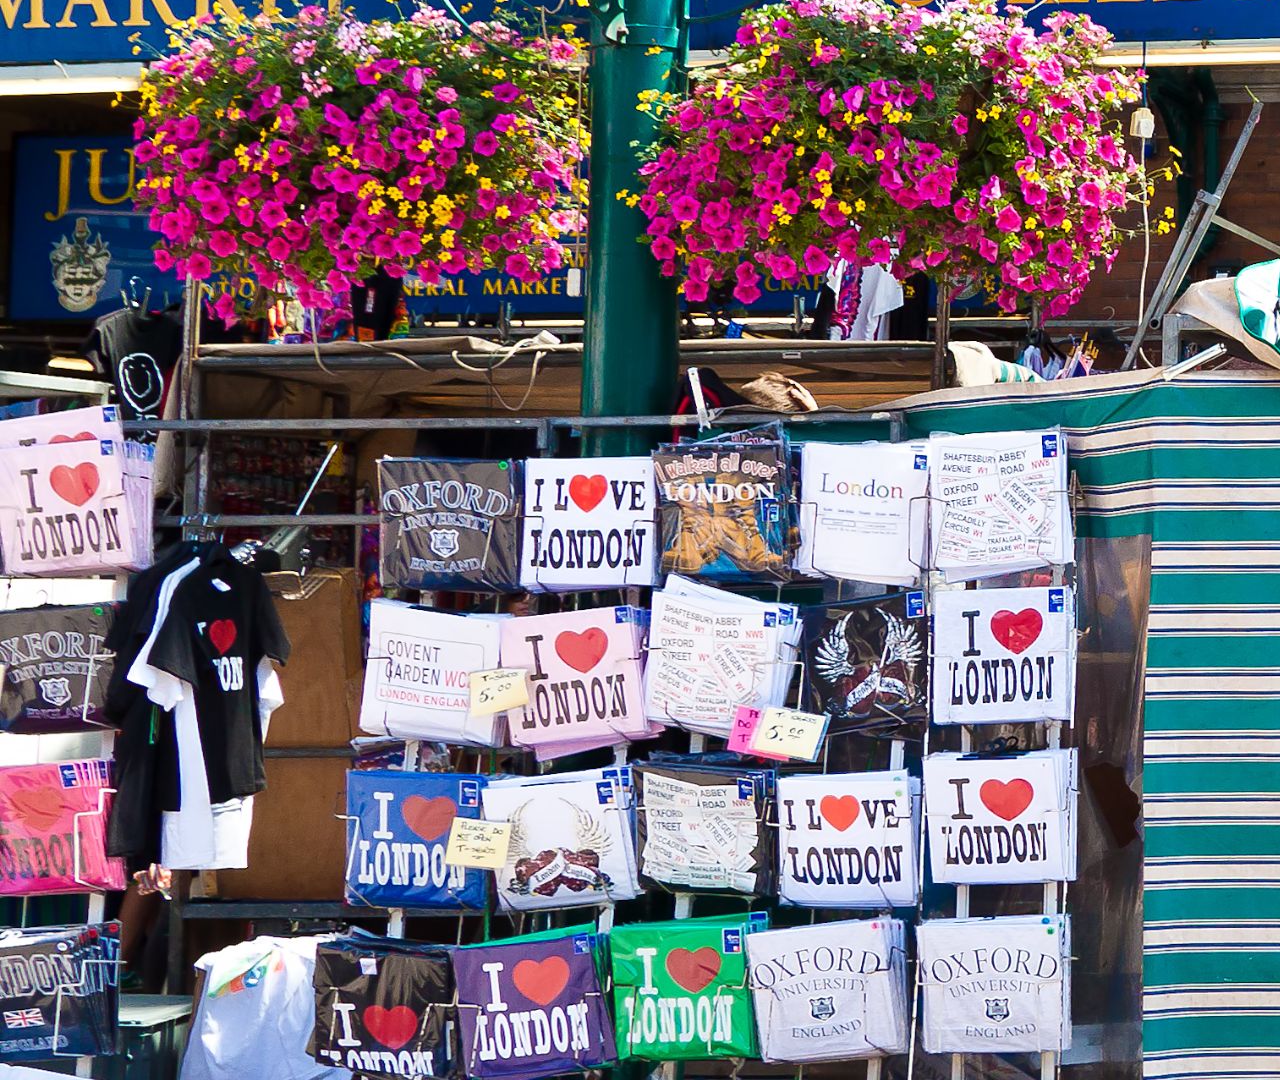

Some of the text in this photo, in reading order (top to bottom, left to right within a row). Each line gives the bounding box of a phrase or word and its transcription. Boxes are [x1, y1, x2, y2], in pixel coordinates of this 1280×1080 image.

[720, 452, 740, 472] all
[741, 459, 780, 481] over
[942, 464, 972, 473] AVENUE
[943, 452, 996, 464] SHAFTESBURY
[998, 450, 1027, 463] ABBEY
[1000, 464, 1025, 476] ROAD
[20, 469, 44, 513] I
[382, 479, 510, 518] OXFORD
[532, 478, 545, 512] I
[663, 482, 779, 504] LONDON
[819, 472, 904, 499] London
[943, 482, 980, 496] OXFORD
[1010, 482, 1036, 507] REGENT
[1002, 491, 1028, 515] STREET
[17, 507, 122, 561] LONDON
[530, 528, 646, 569] LONDON
[409, 557, 482, 573] ENGLAND
[662, 615, 690, 630] AVENUE
[715, 617, 743, 626] ABBEY
[715, 629, 740, 639] ROAD
[962, 609, 981, 657] I
[386, 639, 442, 663] COVENT
[661, 637, 695, 649] OXFORD
[525, 634, 549, 682] I
[444, 670, 470, 689] WC
[949, 655, 1055, 706] LONDON
[379, 687, 470, 709] LONDON ENGLAN
[521, 673, 627, 730] LONDON
[948, 777, 974, 820] I
[372, 791, 394, 840] I
[783, 800, 796, 830] I
[942, 822, 1047, 866] LONDON
[786, 845, 903, 886] LONDON
[635, 947, 659, 997] I
[754, 946, 882, 990] OXFORD
[930, 946, 1059, 985] OXFORD
[482, 961, 508, 1012] I
[772, 978, 870, 1003] UNIVERSITY
[948, 978, 1046, 999] UNIVERSITY
[332, 1002, 361, 1047] I
[478, 1002, 590, 1061] LONDON
[624, 994, 734, 1044] LONDON
[791, 1018, 862, 1040] ENGLAND
[964, 1023, 1036, 1039] ENGLAND
